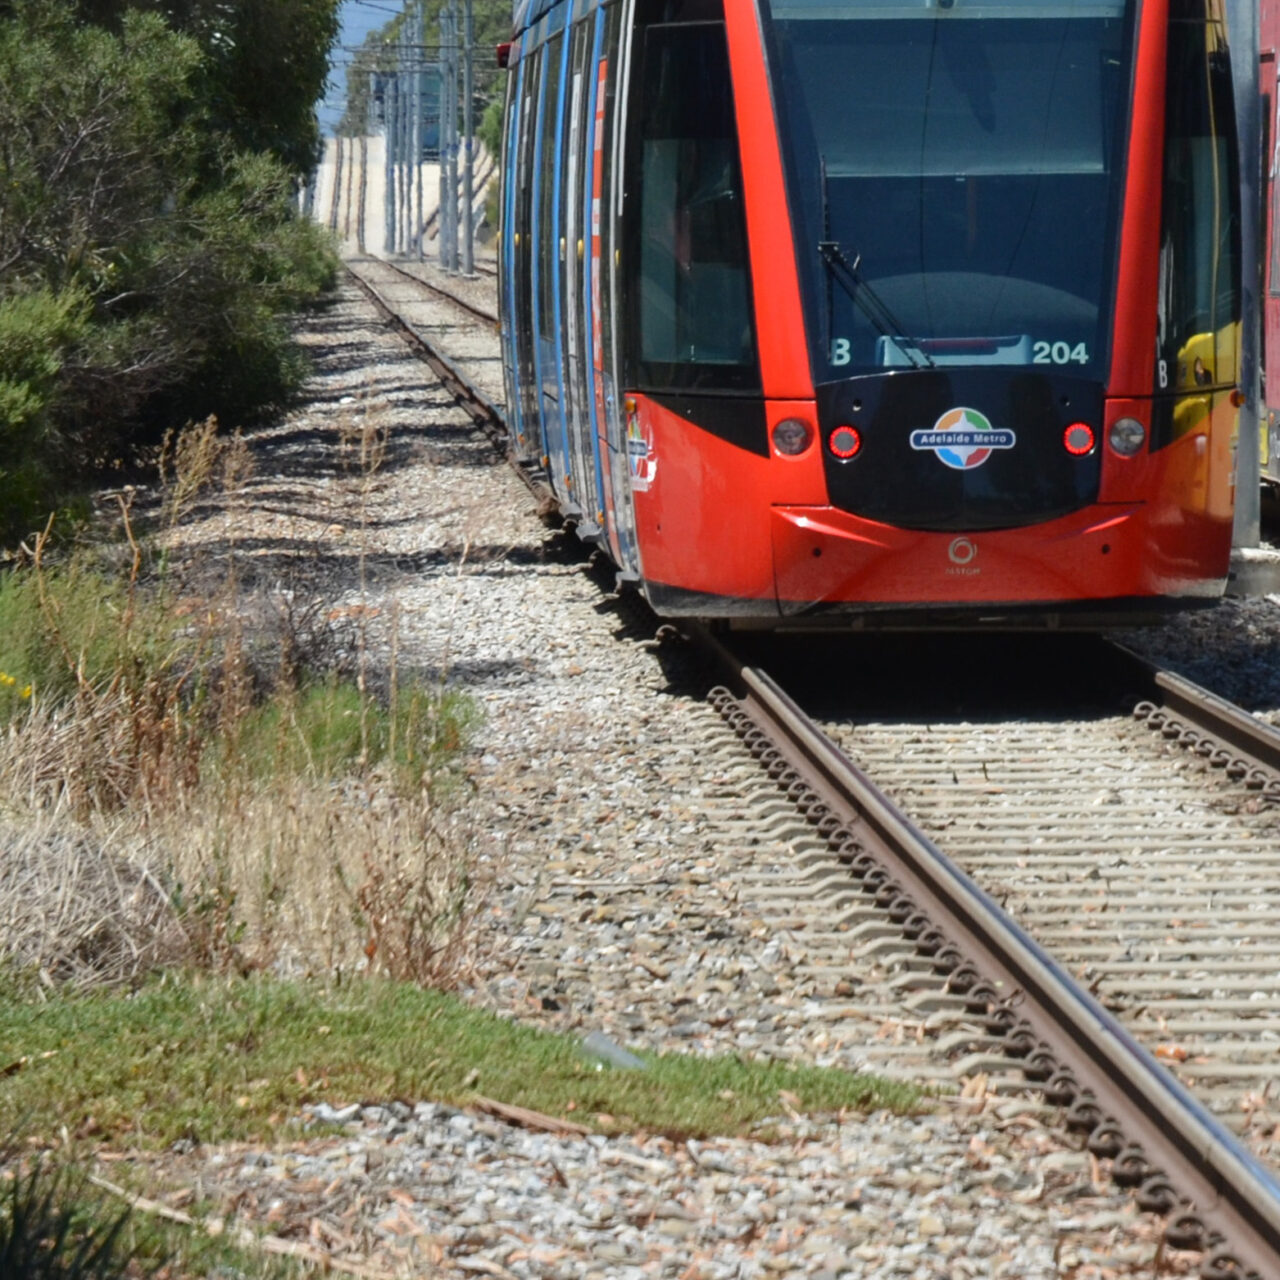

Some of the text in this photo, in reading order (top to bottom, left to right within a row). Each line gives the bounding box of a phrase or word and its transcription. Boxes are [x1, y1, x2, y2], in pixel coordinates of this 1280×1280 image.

[830, 338, 851, 366] B
[1033, 341, 1089, 365] 204
[920, 433, 1007, 444] Adelaide Metro
